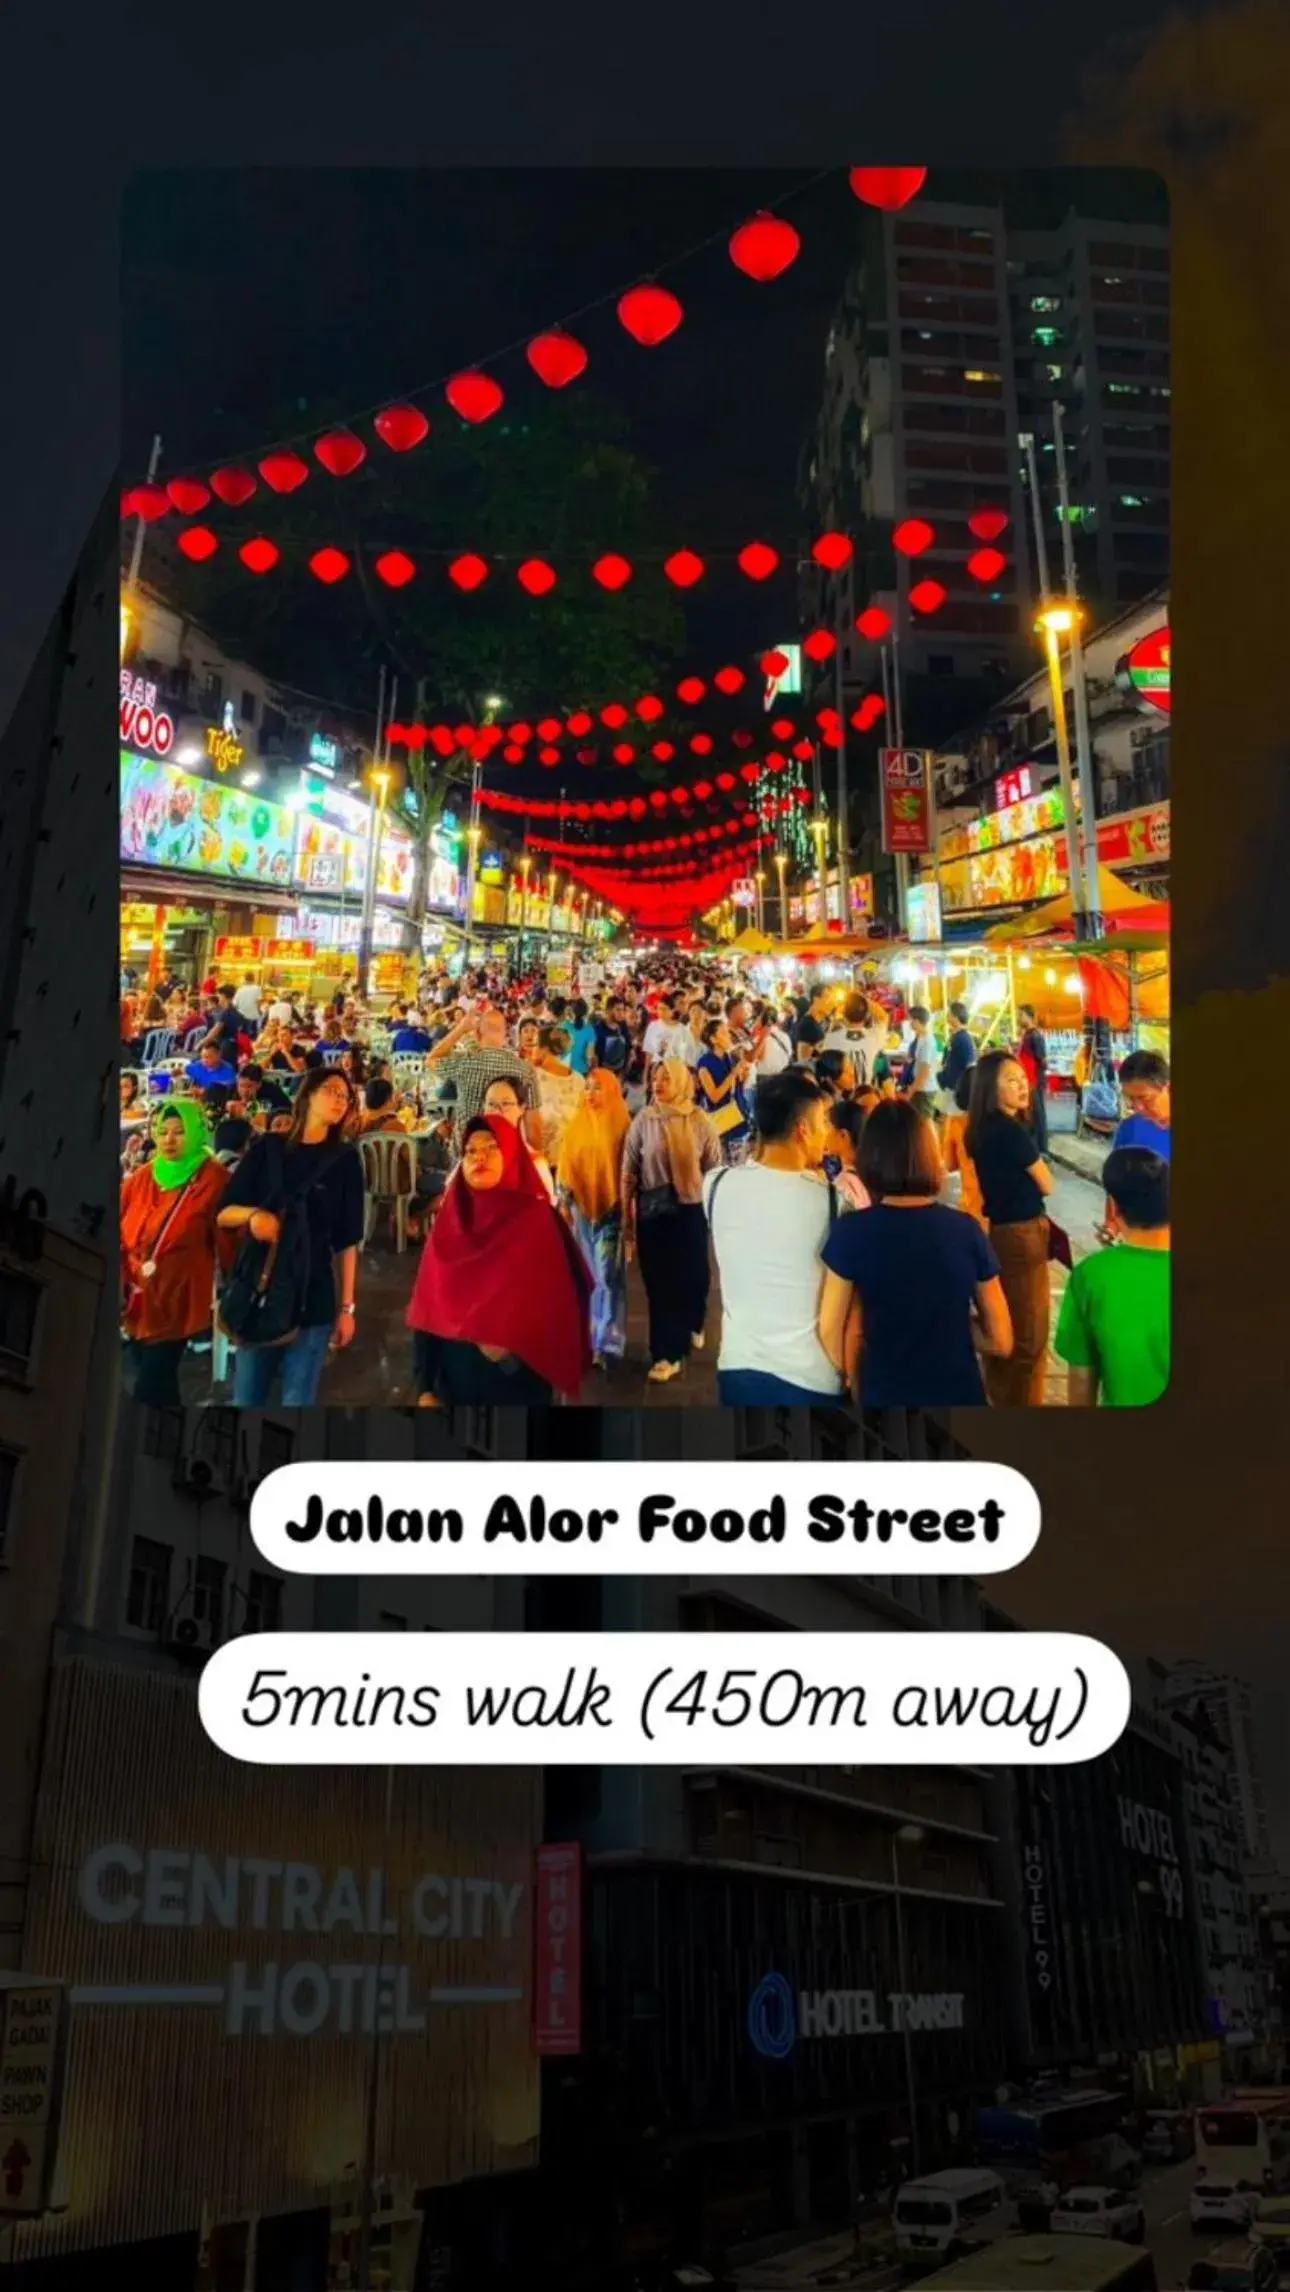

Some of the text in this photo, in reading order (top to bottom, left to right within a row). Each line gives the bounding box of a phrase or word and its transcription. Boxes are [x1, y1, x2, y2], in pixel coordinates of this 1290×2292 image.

[207, 727, 243, 773] Tiger
[887, 751, 923, 777] 4D
[1116, 1794, 1180, 1864] HOTEL
[78, 1843, 524, 1938] CENTRAL CITY
[1024, 1844, 1052, 1992] HOTEL 99
[1160, 1864, 1184, 1920] 99
[548, 1871, 568, 2027] HOTEL
[226, 1960, 426, 2036] HOTEL
[800, 1989, 886, 2037] HOTEL
[4, 2064, 47, 2086] PAWN
[1, 2093, 43, 2115] SHOP
